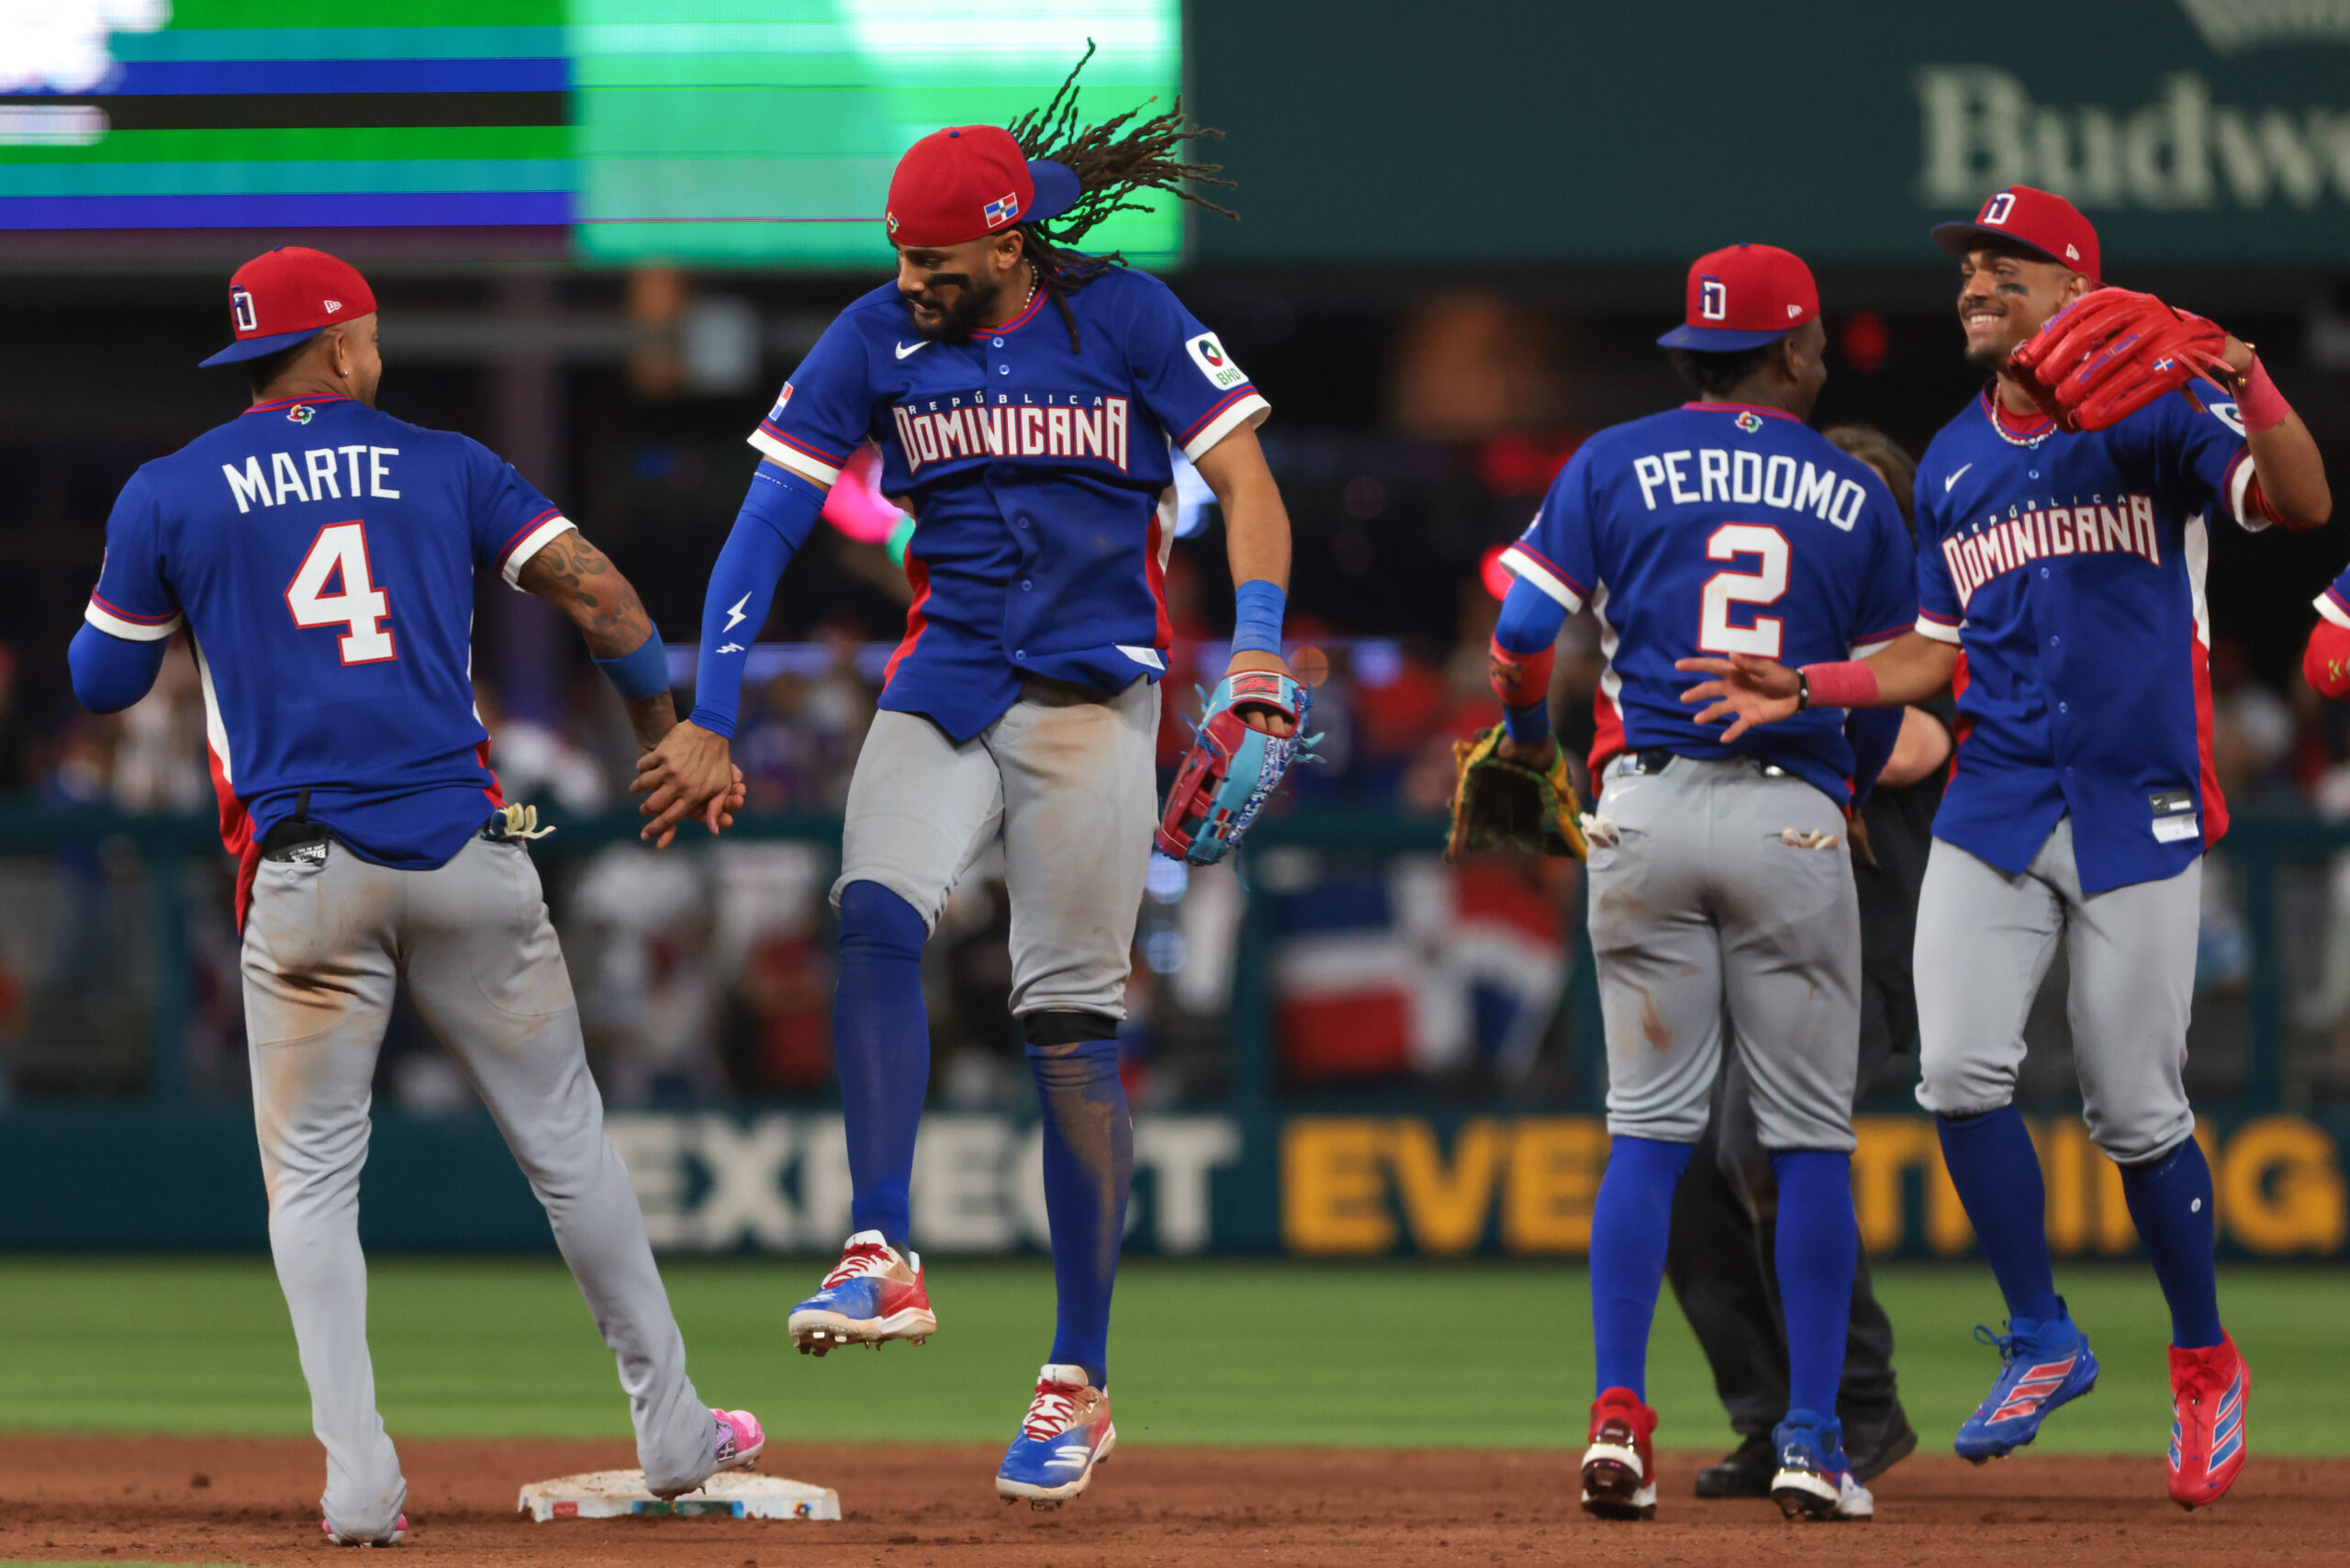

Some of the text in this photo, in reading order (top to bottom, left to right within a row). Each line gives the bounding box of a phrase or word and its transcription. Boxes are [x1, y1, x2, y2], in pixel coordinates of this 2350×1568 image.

[1915, 62, 2350, 211] Budw
[908, 391, 1102, 415] REPÚBLICA
[1215, 368, 1241, 386] BHD
[891, 396, 1128, 476] DOMINICANA
[222, 445, 400, 514] MARTE
[1633, 448, 1866, 532] PERDOMO
[1956, 493, 2127, 543] REPÚBLICA
[283, 519, 397, 667] 4
[1697, 521, 1793, 661] 2
[1941, 493, 2162, 612] DOMINICANA
